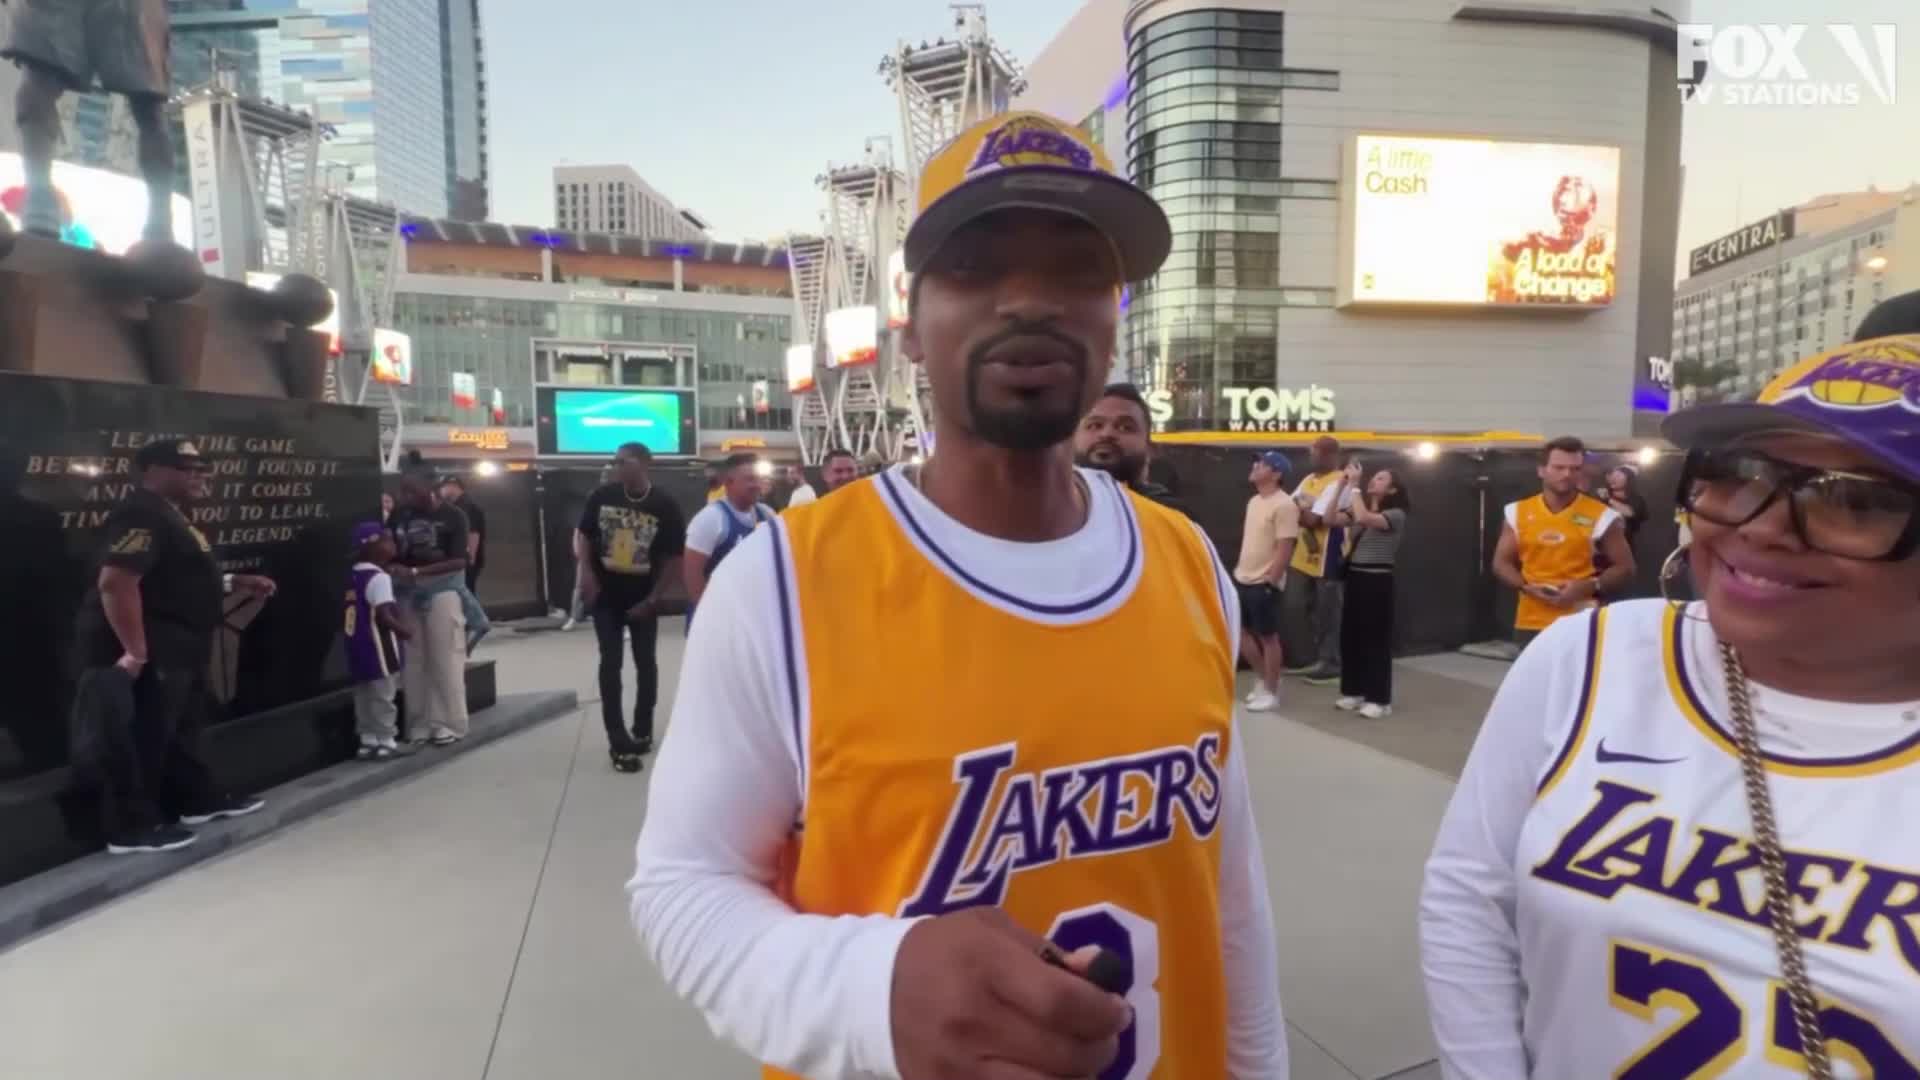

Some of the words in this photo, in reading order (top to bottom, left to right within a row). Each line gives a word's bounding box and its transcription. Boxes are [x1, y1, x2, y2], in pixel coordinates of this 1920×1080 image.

[1367, 145, 1382, 164] A
[1365, 171, 1428, 194] Cash
[1516, 248, 1535, 272] A
[1538, 246, 1583, 272] load
[1514, 272, 1608, 301] Change
[1222, 385, 1335, 421] TOM'S
[1229, 420, 1289, 432] WATCH
[1297, 421, 1329, 432] BAR
[197, 434, 239, 453] THE
[245, 438, 296, 454] GAME
[211, 458, 248, 476] YOU
[257, 459, 316, 476] FOUND
[322, 460, 339, 477] IT
[224, 483, 244, 499] IT
[252, 482, 313, 498] COMES
[59, 511, 111, 529] TIM
[191, 506, 230, 523] YOU
[239, 505, 263, 521] TO
[897, 732, 1224, 918] LAKERS
